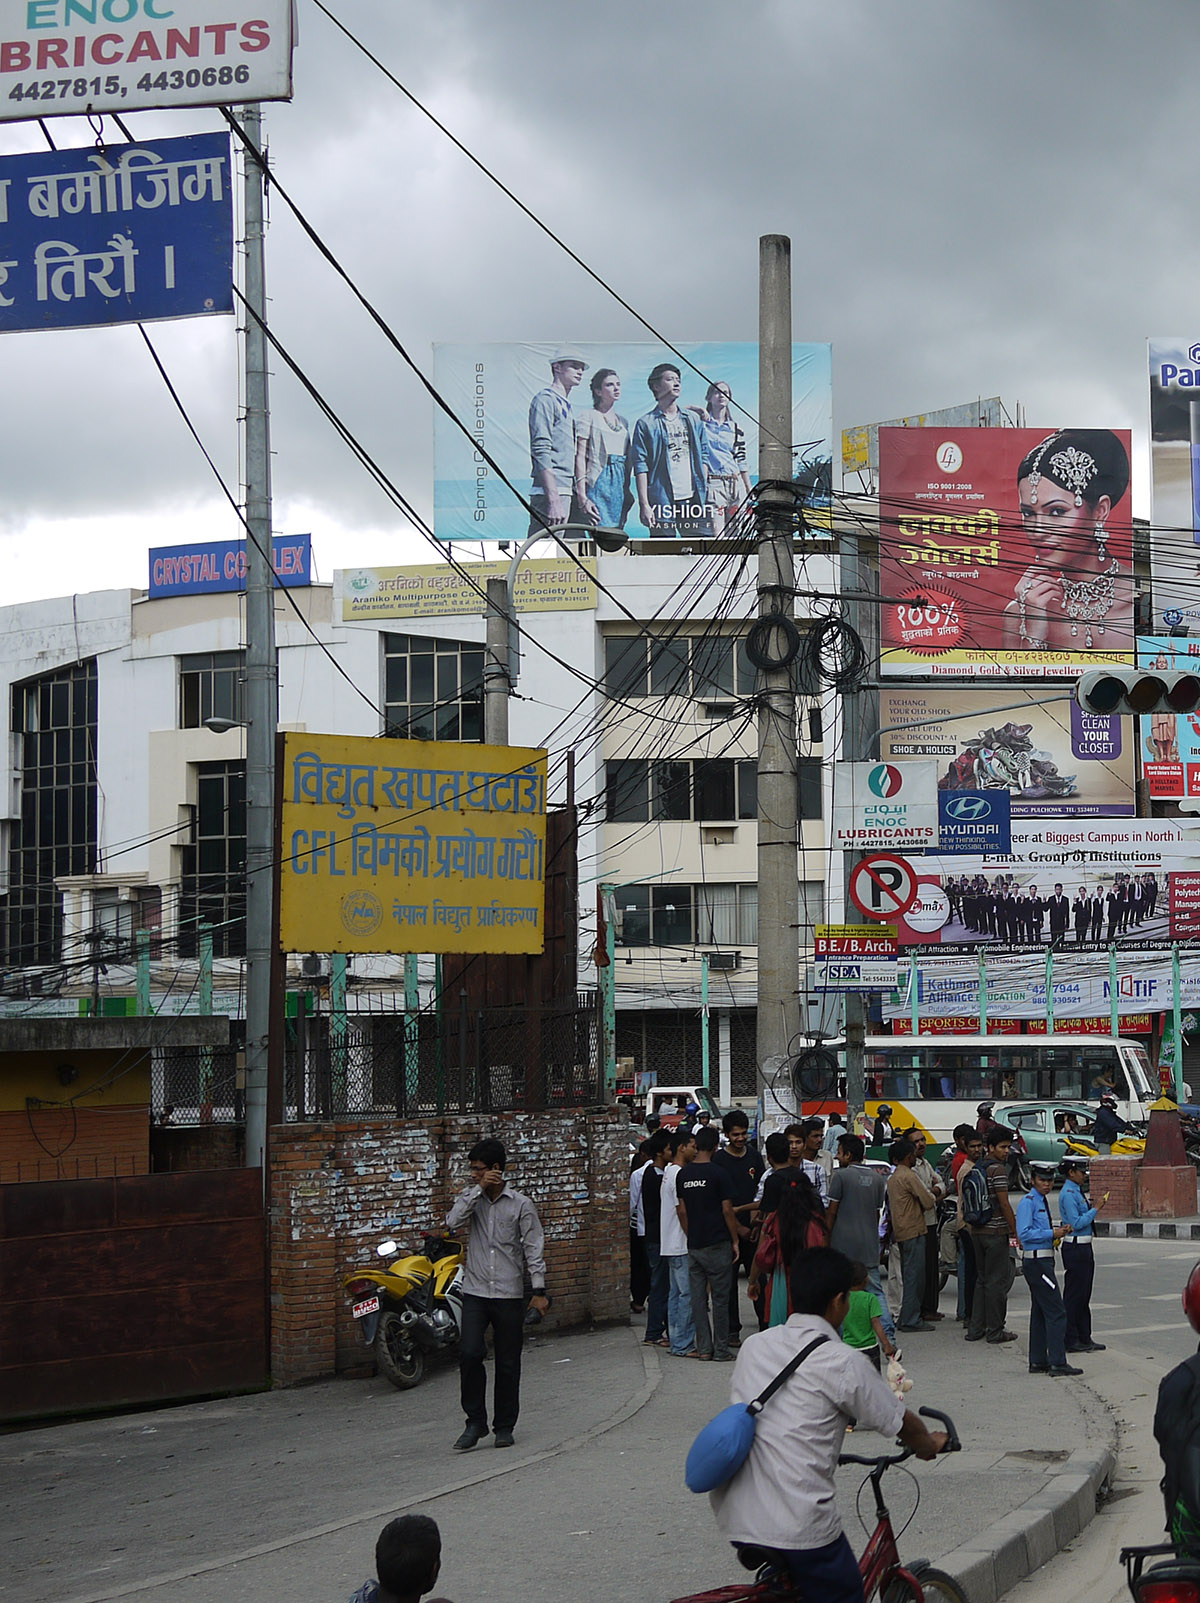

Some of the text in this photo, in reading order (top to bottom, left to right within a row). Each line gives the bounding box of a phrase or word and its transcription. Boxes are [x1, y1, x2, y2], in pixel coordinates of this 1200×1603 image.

[9, 64, 249, 101] 4427815, 4430686
[474, 363, 488, 522] Spring Collections
[153, 545, 304, 588] CRYSTAL COLEX
[352, 588, 567, 605] Araniko Multipurpose Society
[931, 665, 1085, 677] Diamond, Gold Silver Jewellery
[1081, 718, 1110, 729] CLEAN
[1083, 731, 1109, 742] YOUR
[892, 745, 915, 754] SHOE
[926, 745, 954, 754] HOLICS
[1079, 743, 1113, 754] CLOSET
[293, 752, 378, 819] विद्युत
[381, 766, 465, 812] खपत
[865, 817, 907, 827] ENOC
[838, 827, 934, 840] LUBRICANTS
[939, 824, 1000, 836] HYUNDAI
[1032, 831, 1174, 845] at Biggest Campus in North
[292, 829, 345, 876] CFL
[433, 827, 496, 880] प्रयोग
[982, 850, 1161, 866] E-max Group of Institutions
[392, 898, 428, 926] नेपाल
[432, 898, 472, 934] विद्युत
[476, 899, 539, 927] प्राधिकरण
[819, 939, 895, 953] B.E. B. Arch.
[928, 944, 959, 953] Attraction
[1012, 943, 1049, 953] Engineering
[1099, 941, 1107, 949] to
[1142, 941, 1149, 949] of
[1150, 941, 1170, 950] Degree
[854, 954, 888, 962] Preparation
[830, 966, 860, 979] SEA
[928, 992, 973, 1003] Alliance
[921, 1017, 965, 1031] SPORTS
